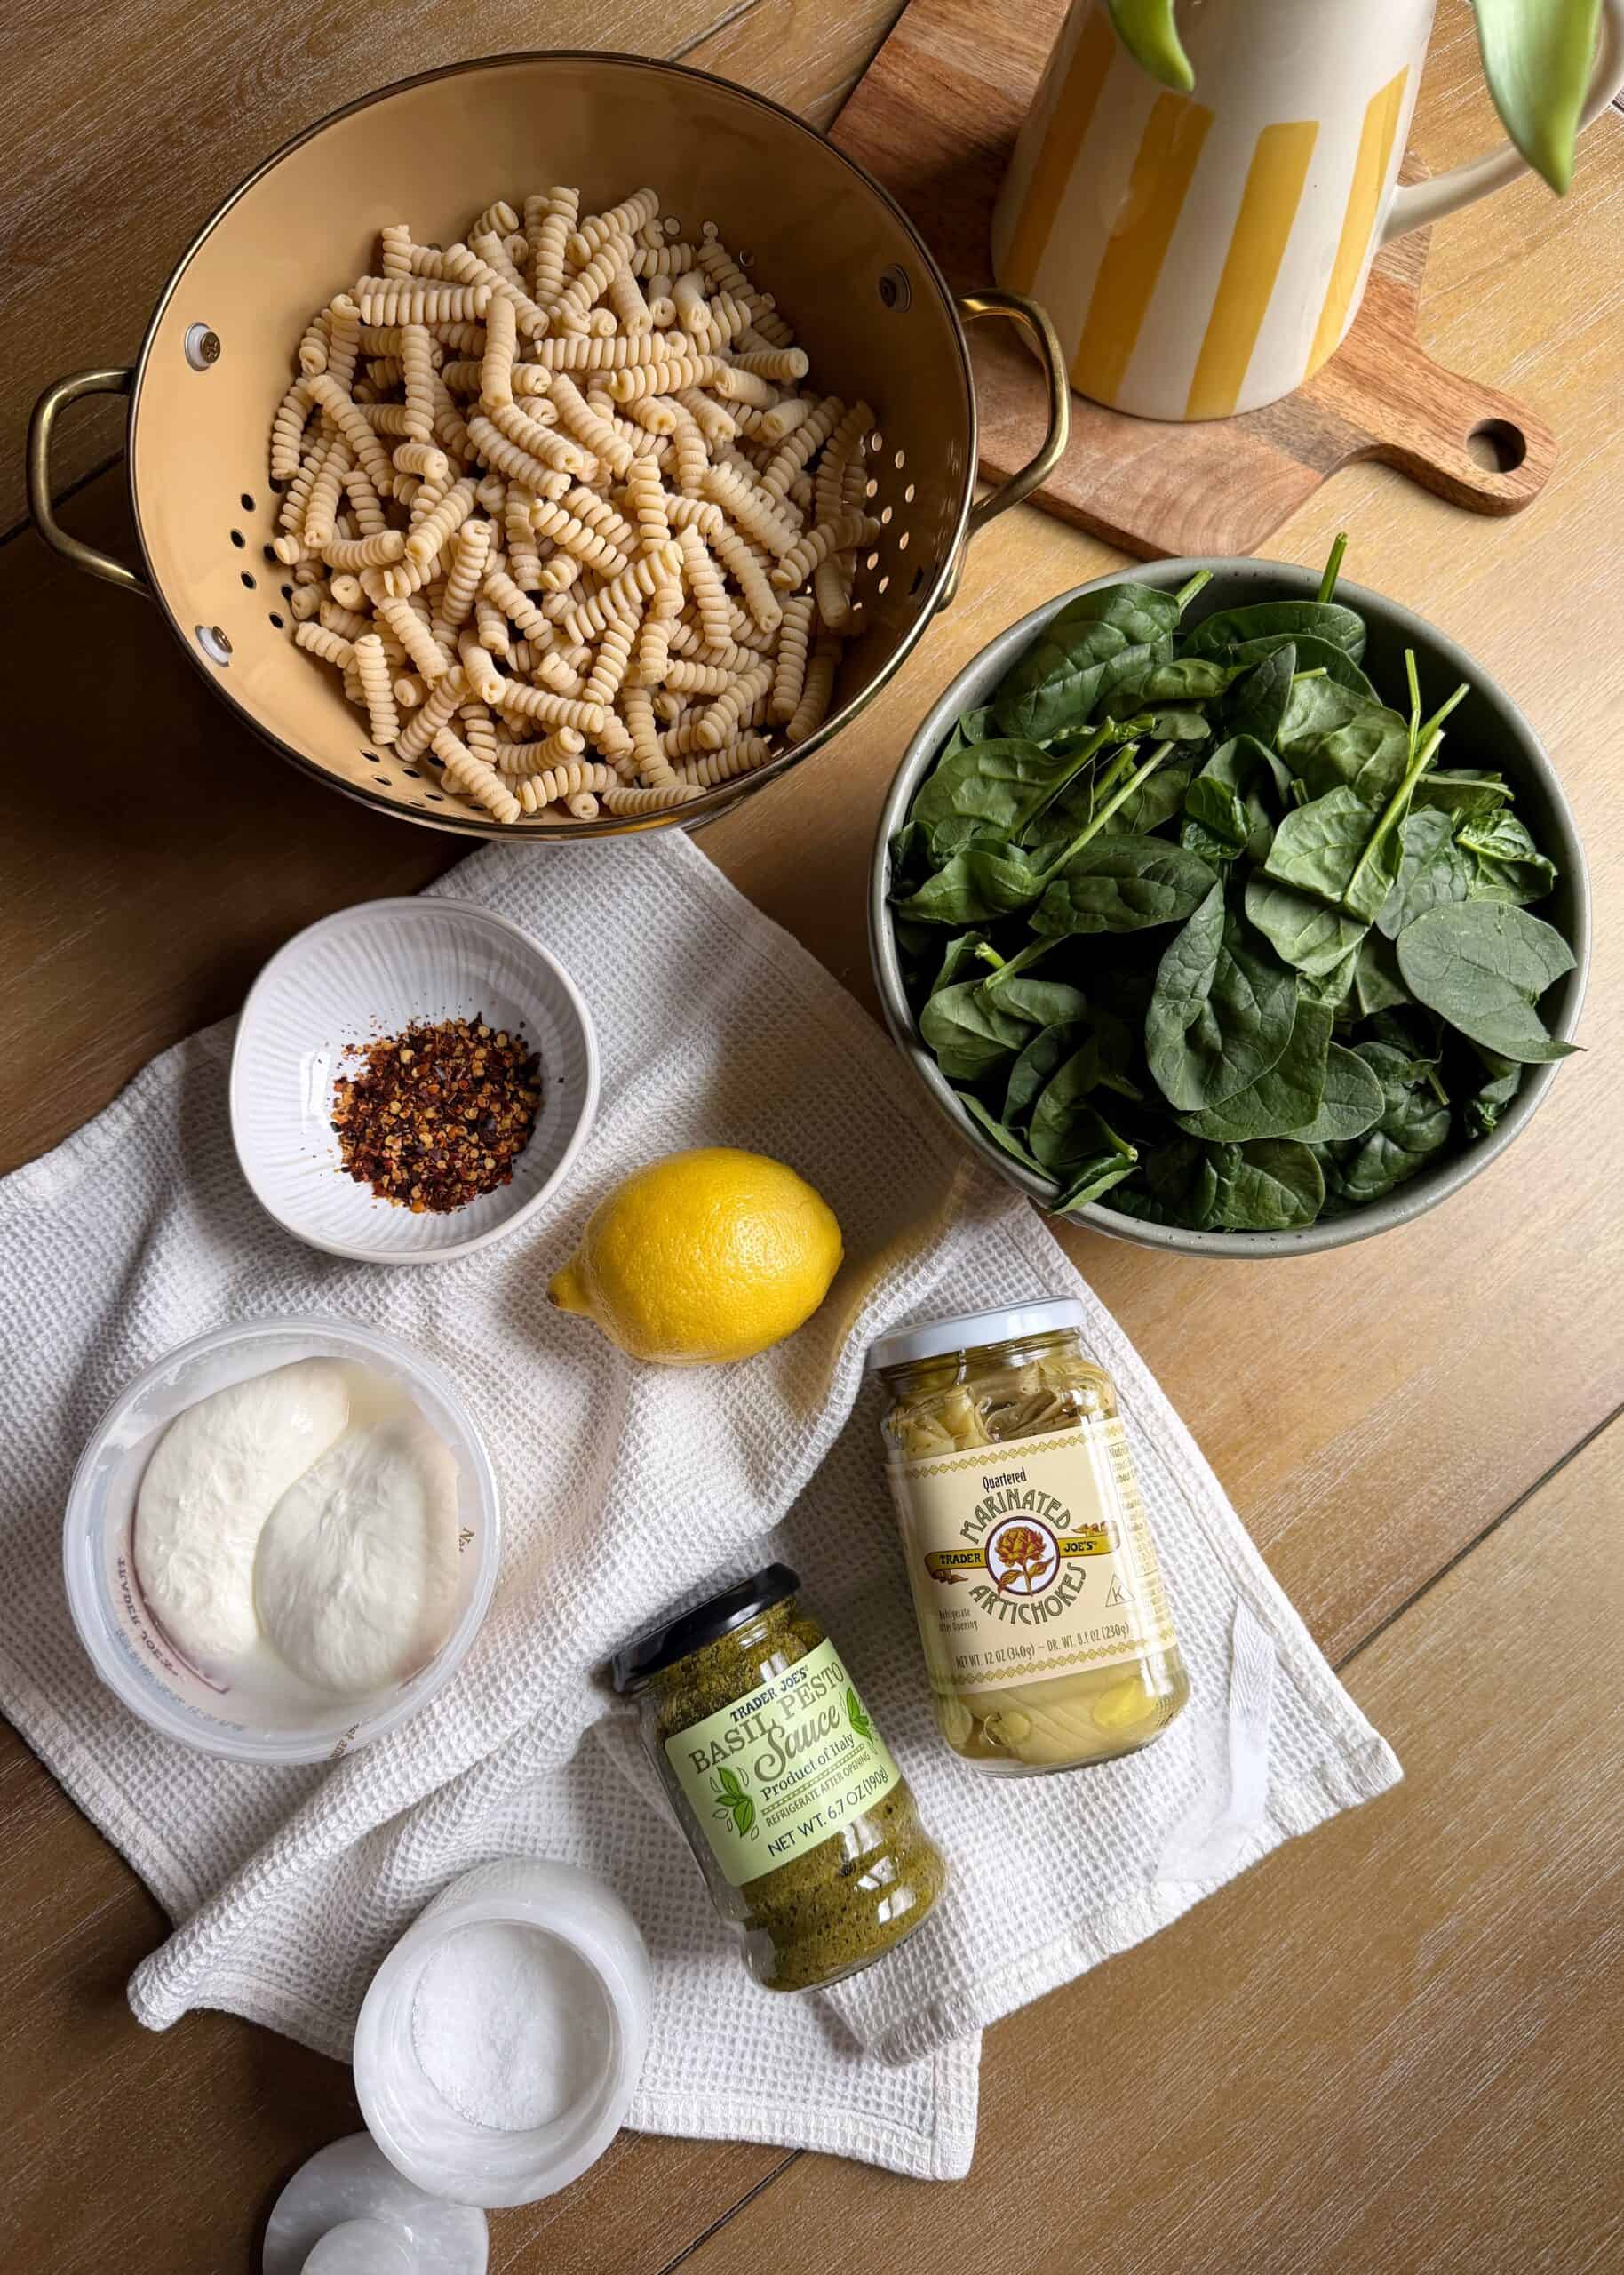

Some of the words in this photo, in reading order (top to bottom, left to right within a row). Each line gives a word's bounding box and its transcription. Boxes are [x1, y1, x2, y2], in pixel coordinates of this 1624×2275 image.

[982, 1467, 1028, 1493] Quartered
[960, 1488, 1071, 1545] MARINATED
[939, 1553, 982, 1565] TRADER
[1063, 1541, 1094, 1553] JOE'S
[968, 1562, 1087, 1625] ARTICHOKES
[952, 1620, 979, 1632] Opening
[955, 1655, 967, 1669] NET
[984, 1650, 994, 1664] 12
[995, 1648, 1006, 1663] OZ
[1007, 1642, 1035, 1664] (340g)
[1047, 1638, 1060, 1651] DR.
[1090, 1629, 1102, 1644] OZ
[1102, 1621, 1130, 1642] (230g)
[689, 1711, 778, 1775] BASIL
[777, 1662, 845, 1720] PESTO
[729, 1688, 777, 1722] TRADER
[781, 1665, 808, 1692] JOE'S
[754, 1704, 840, 1782] Sauce
[760, 1759, 818, 1801] Product
[818, 1747, 832, 1766] of
[831, 1733, 855, 1757] Italy
[765, 1789, 821, 1827] REFRIGERATE
[820, 1773, 844, 1794] AFTER
[843, 1751, 872, 1777] OPENING
[767, 1830, 797, 1856] NET
[797, 1813, 827, 1837] WT.
[827, 1800, 845, 1820] 6.7
[846, 1785, 866, 1807] OZ
[865, 1765, 890, 1796] (190g)
